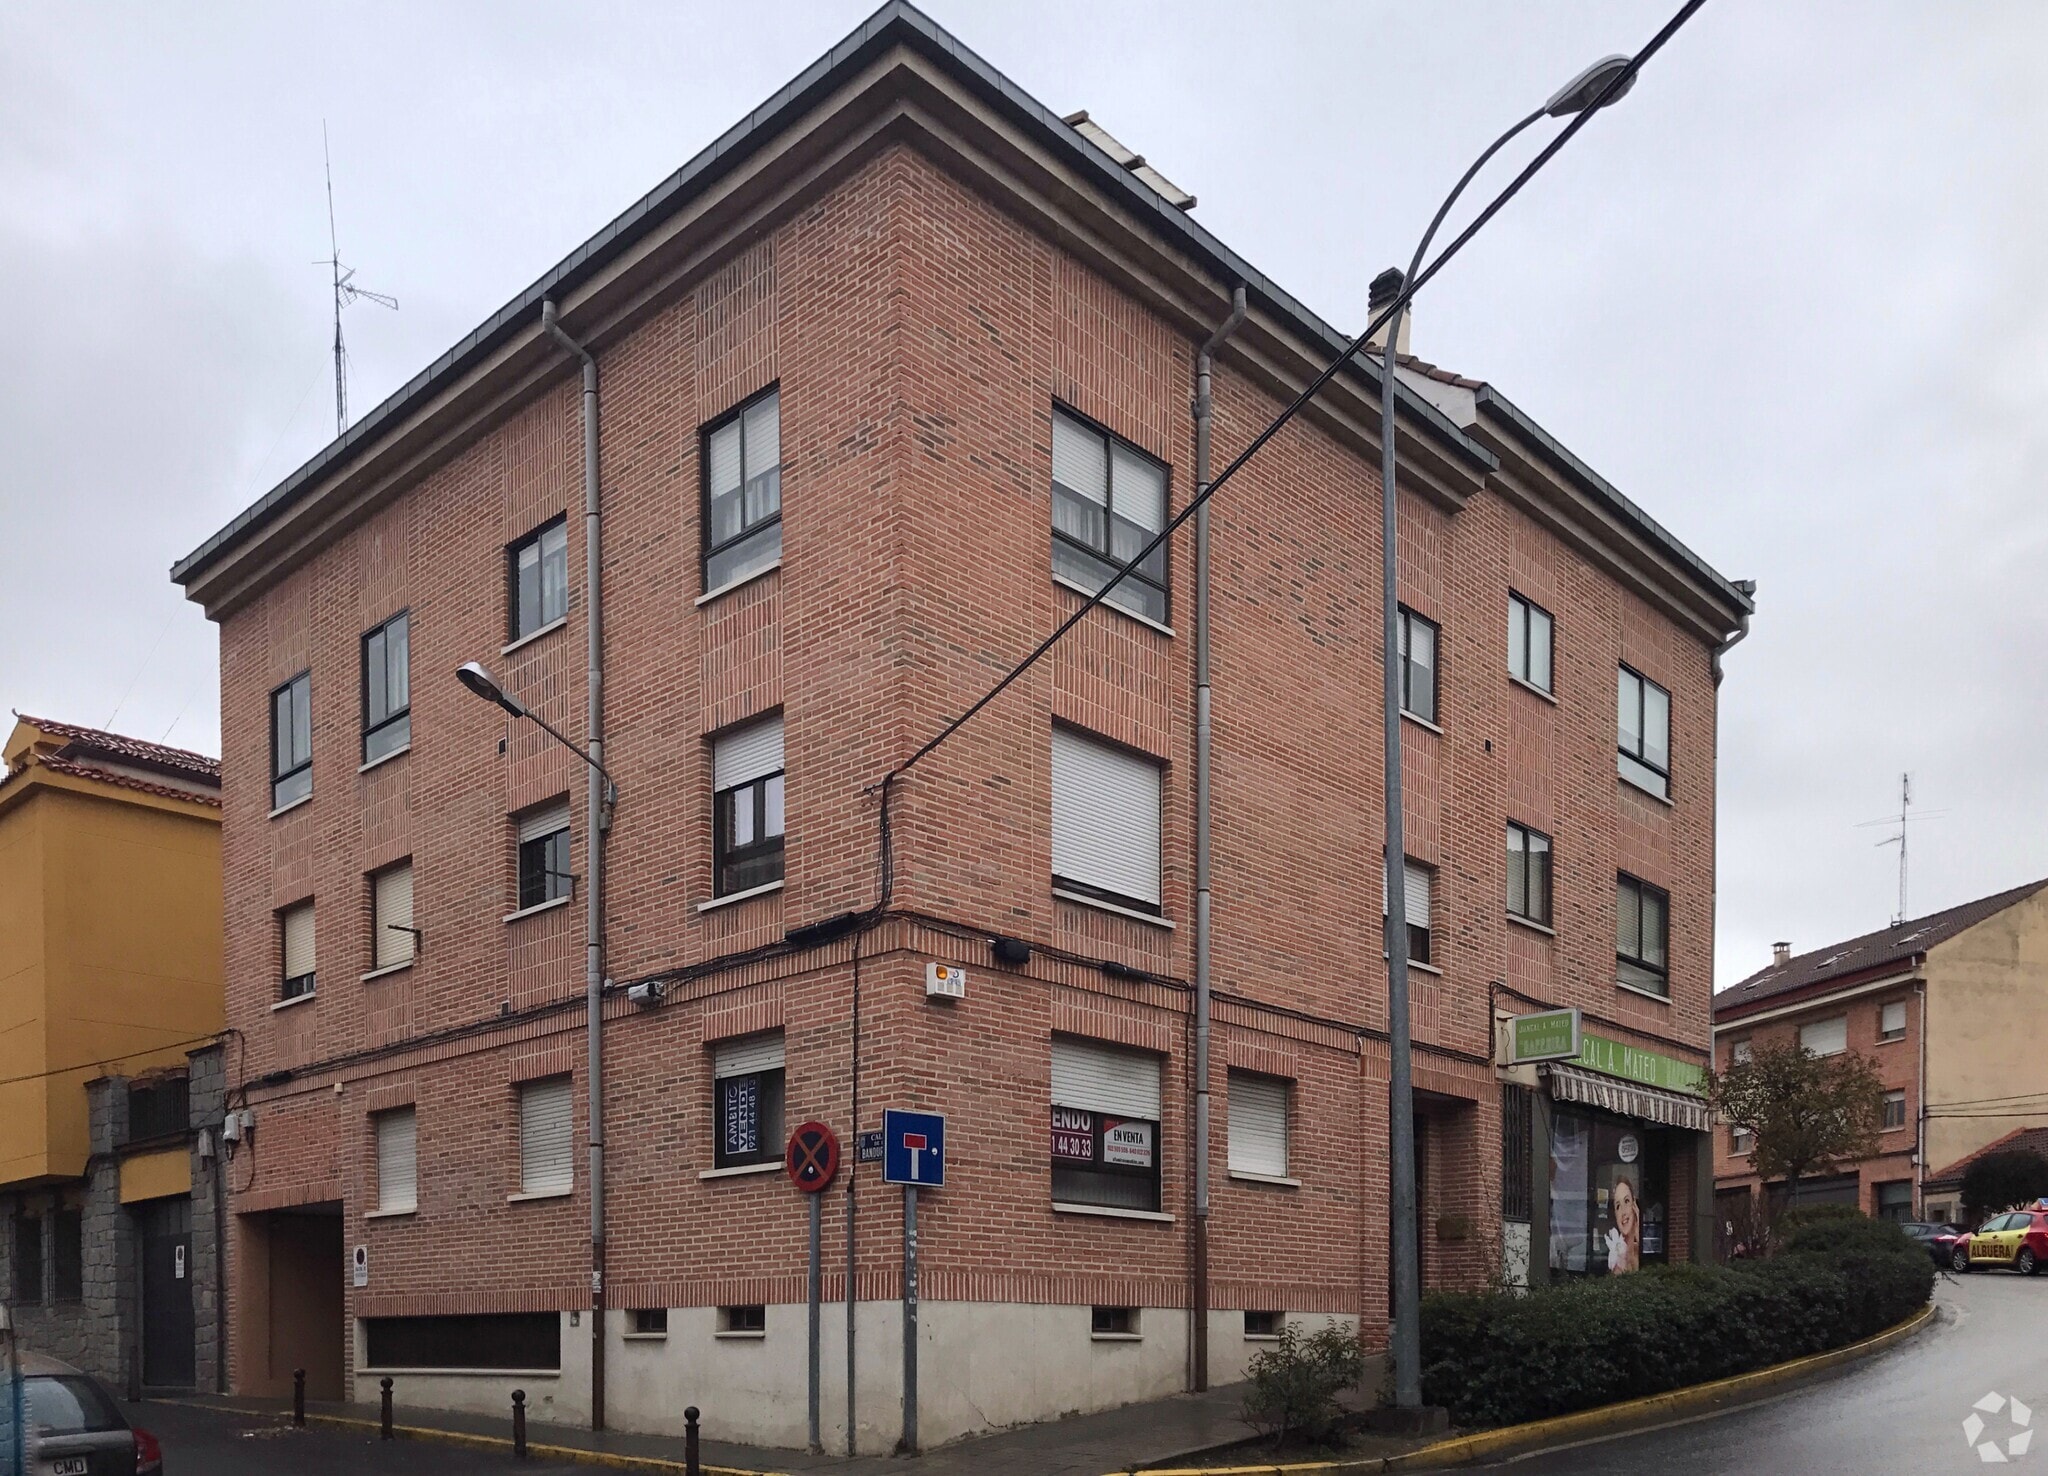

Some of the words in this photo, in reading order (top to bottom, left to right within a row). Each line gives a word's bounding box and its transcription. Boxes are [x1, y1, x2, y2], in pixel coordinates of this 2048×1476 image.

[1624, 1046, 1657, 1083] MATEO
[749, 1095, 756, 1108] 48
[749, 1111, 756, 1125] 44
[1052, 1108, 1091, 1131] ENDO
[1113, 1129, 1122, 1142] EN
[1123, 1131, 1144, 1145] VENTA
[1058, 1136, 1068, 1154] 44
[1070, 1137, 1080, 1155] 30
[1081, 1138, 1092, 1157] 33
